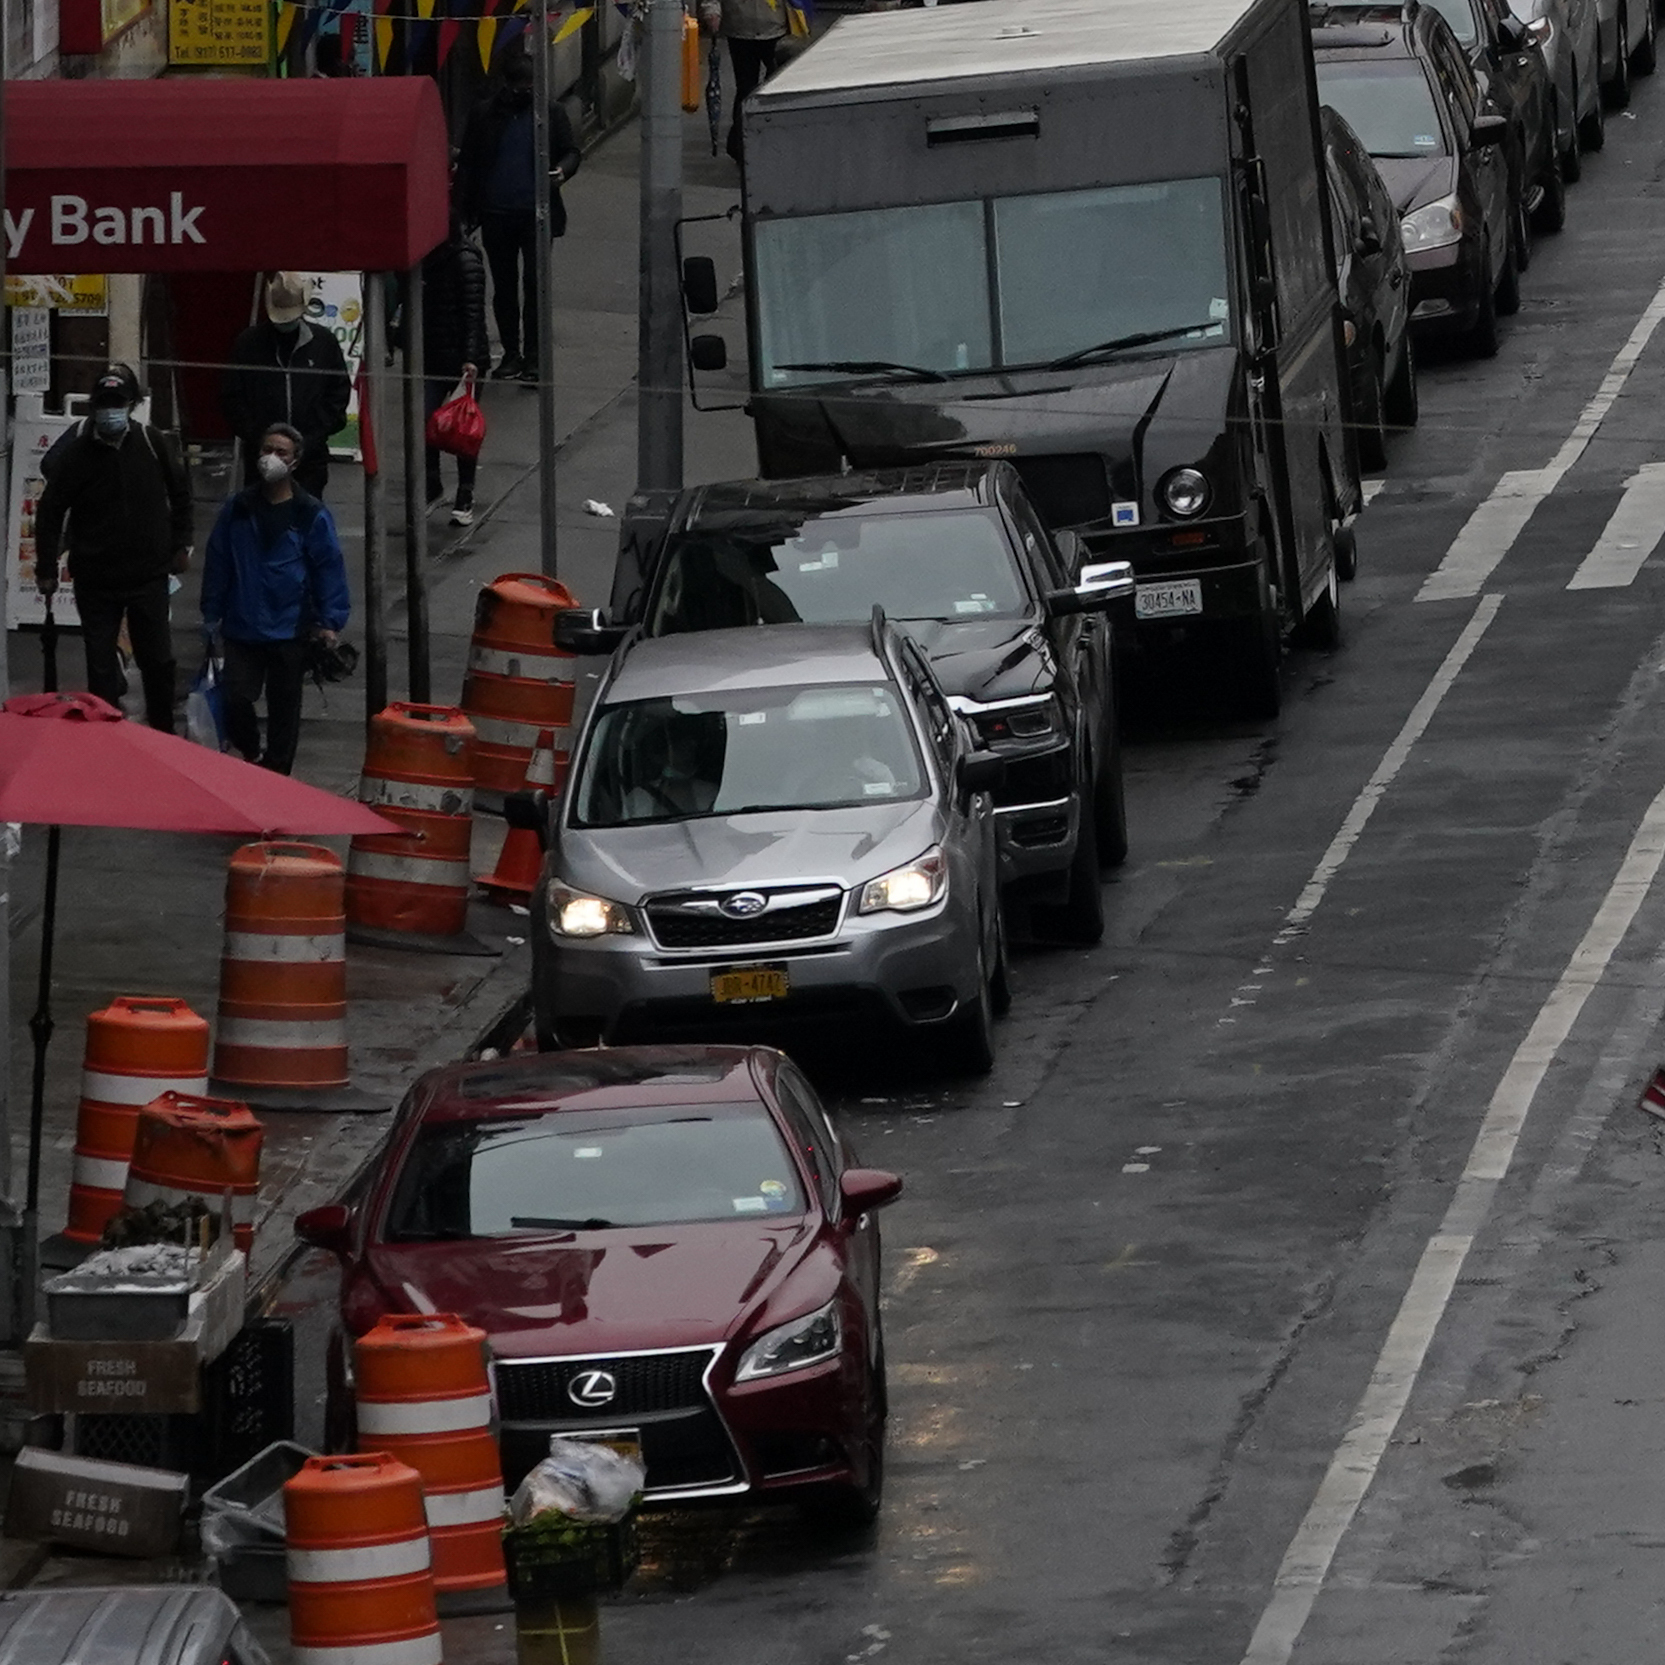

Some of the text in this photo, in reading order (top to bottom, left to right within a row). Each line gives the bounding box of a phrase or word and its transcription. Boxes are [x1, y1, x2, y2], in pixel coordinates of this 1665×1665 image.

[51, 191, 207, 247] Bank
[86, 1359, 137, 1376] FRESH
[77, 1380, 148, 1397] SEAFOOD
[65, 1489, 122, 1514] FRESH
[50, 1507, 132, 1538] SEAFOOD
